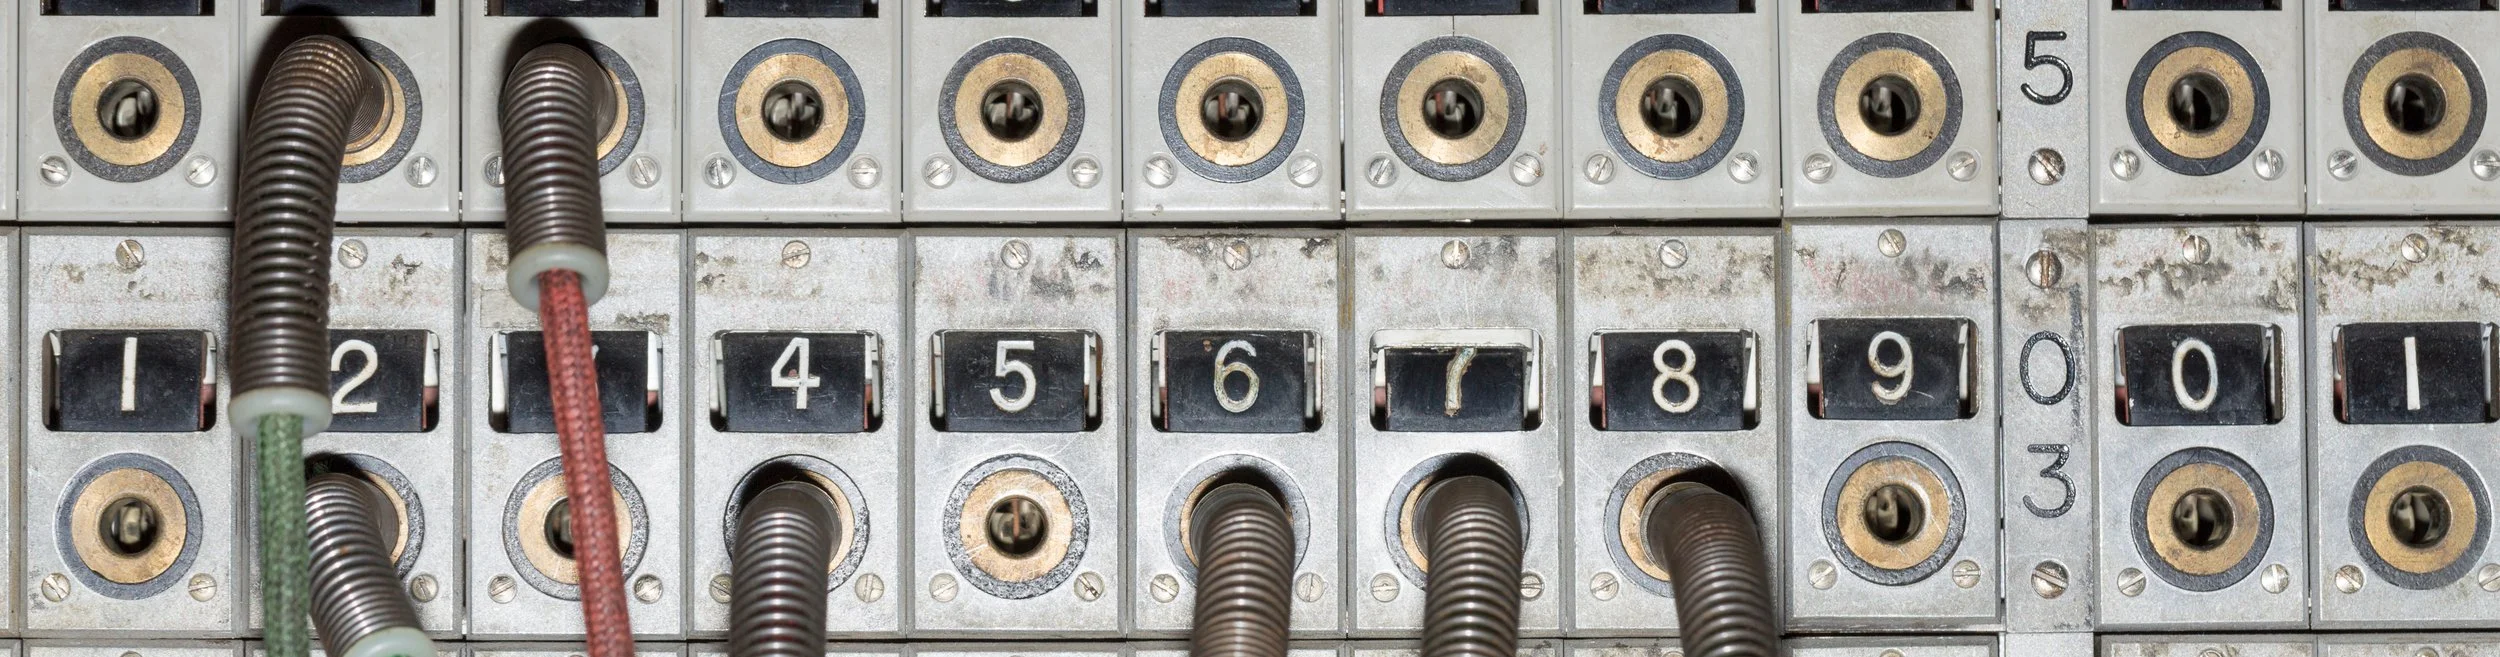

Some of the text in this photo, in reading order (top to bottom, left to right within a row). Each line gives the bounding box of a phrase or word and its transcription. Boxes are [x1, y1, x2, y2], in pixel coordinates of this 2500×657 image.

[2021, 31, 2072, 105] 5
[121, 337, 137, 411] 1
[330, 339, 379, 414] 2
[770, 337, 821, 410] 4
[989, 340, 1037, 413] 5
[1213, 340, 1260, 413] 6
[1651, 339, 1700, 413] 8
[1867, 331, 1914, 405] 9
[2171, 337, 2219, 411] 0
[2403, 337, 2421, 411] 1
[2023, 443, 2076, 518] 3
